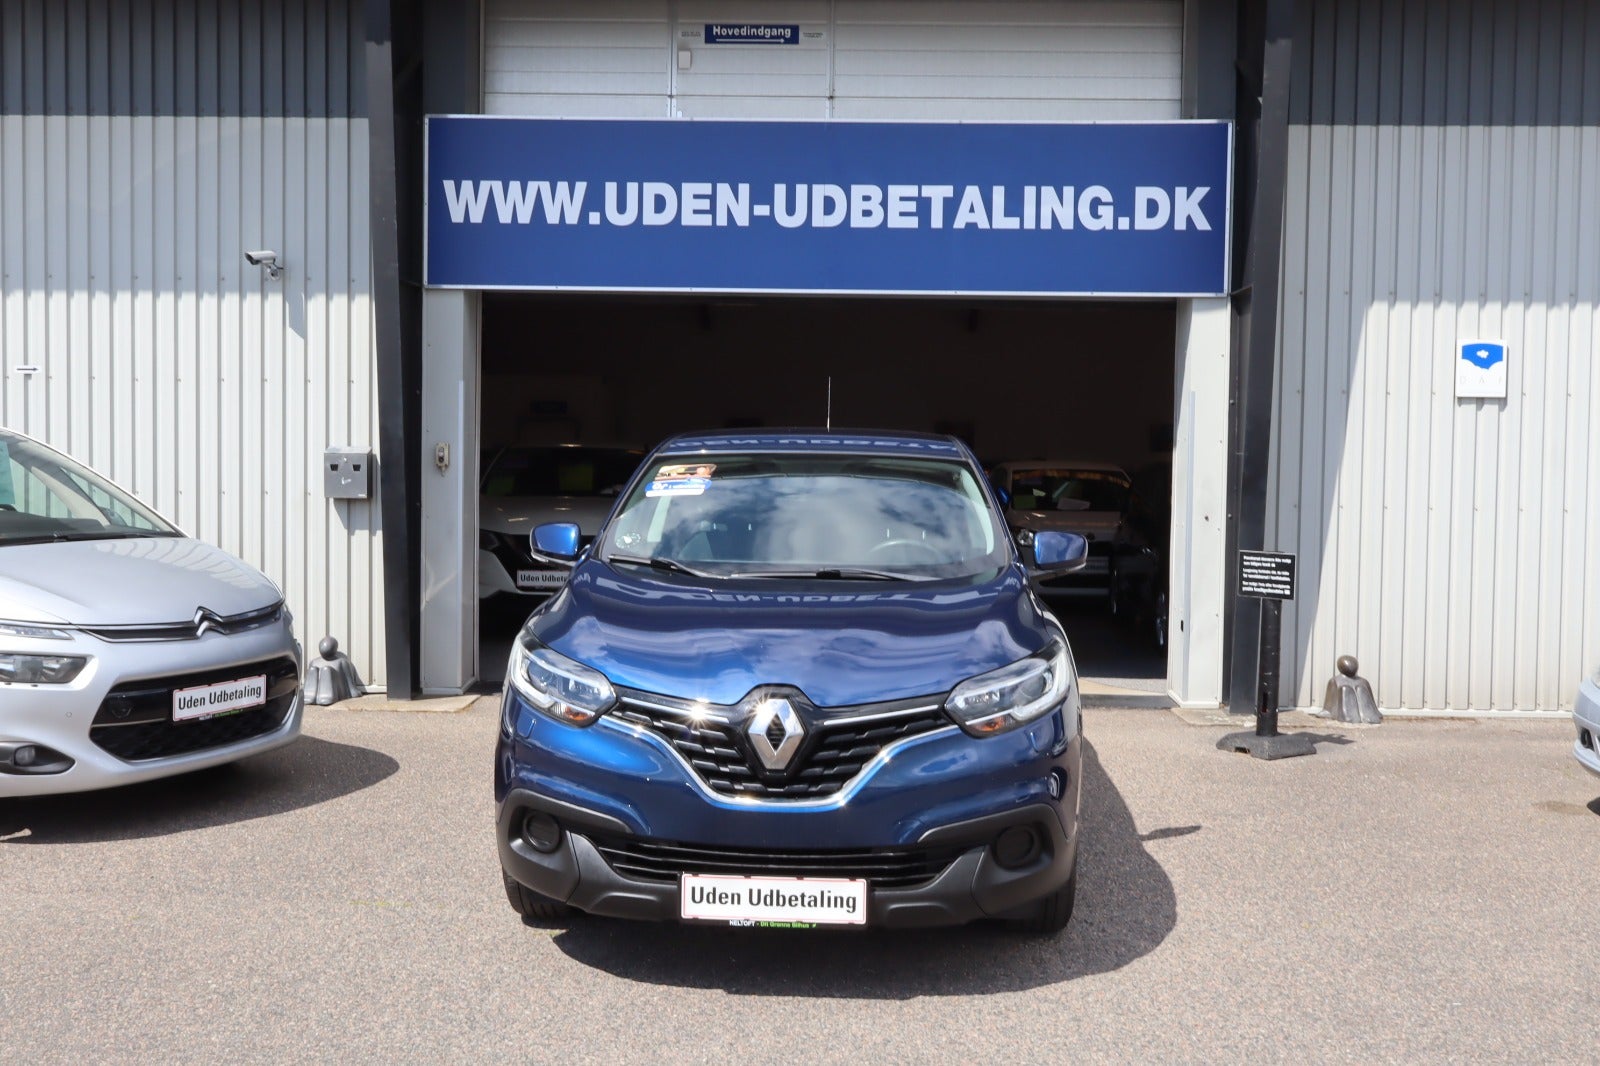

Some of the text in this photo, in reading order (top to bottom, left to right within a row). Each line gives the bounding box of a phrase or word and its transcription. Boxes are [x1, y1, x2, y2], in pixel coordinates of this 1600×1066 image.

[713, 25, 791, 38] Hovedindgang
[443, 179, 1212, 231] WWW.UDEN-UDBETALING.DK
[178, 685, 262, 710] Uden Udbetaling
[691, 886, 857, 914] Uden Udbetaling
